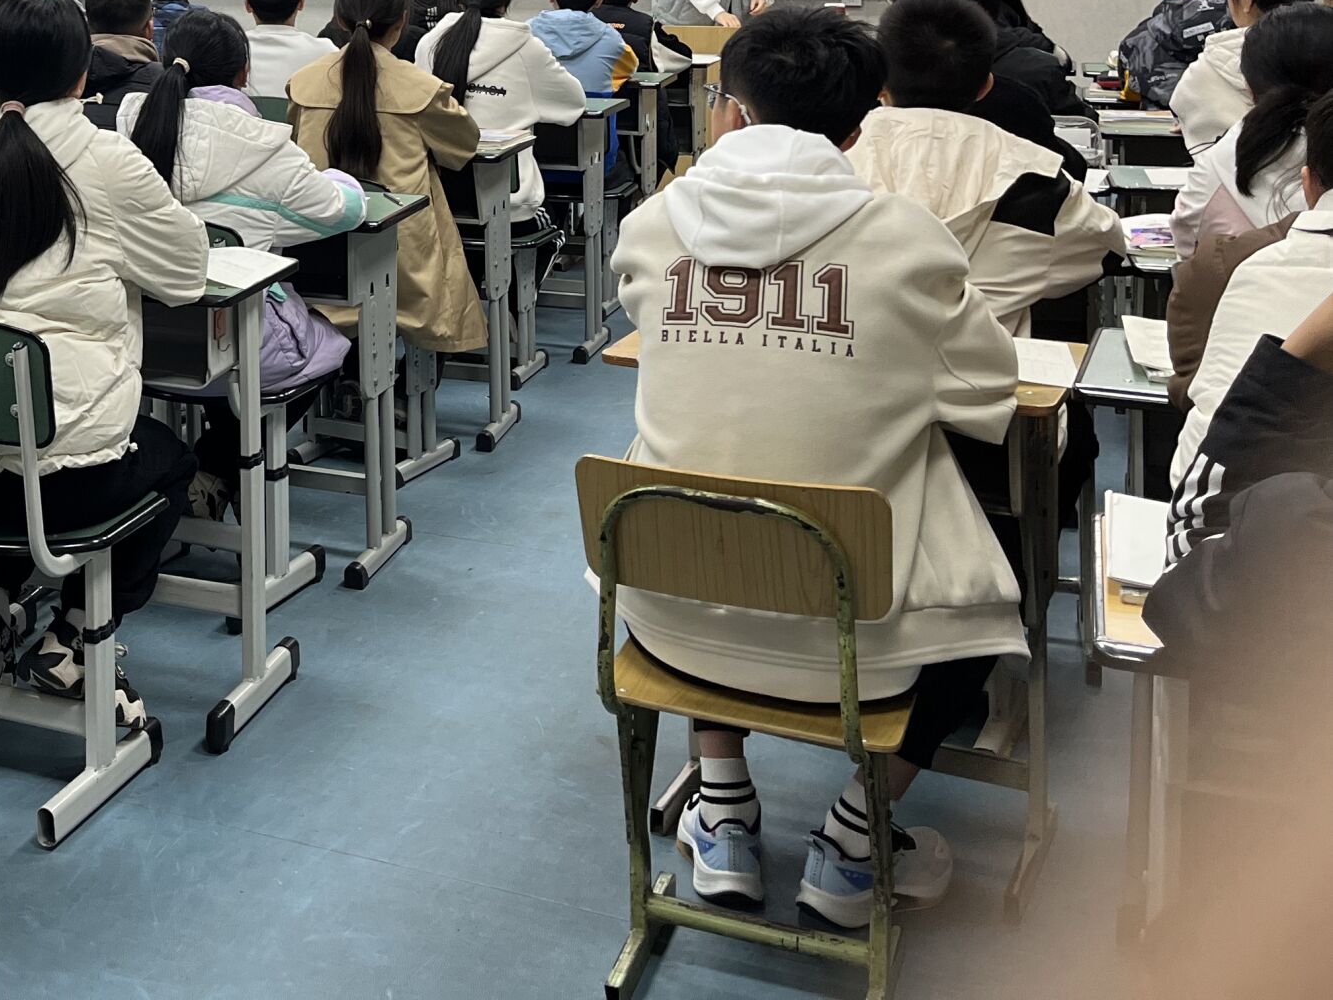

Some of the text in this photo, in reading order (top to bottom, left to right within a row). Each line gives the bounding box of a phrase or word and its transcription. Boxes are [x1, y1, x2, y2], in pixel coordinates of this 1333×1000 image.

[662, 256, 854, 339] 1911
[661, 329, 854, 357] BIELLA ITALIA
